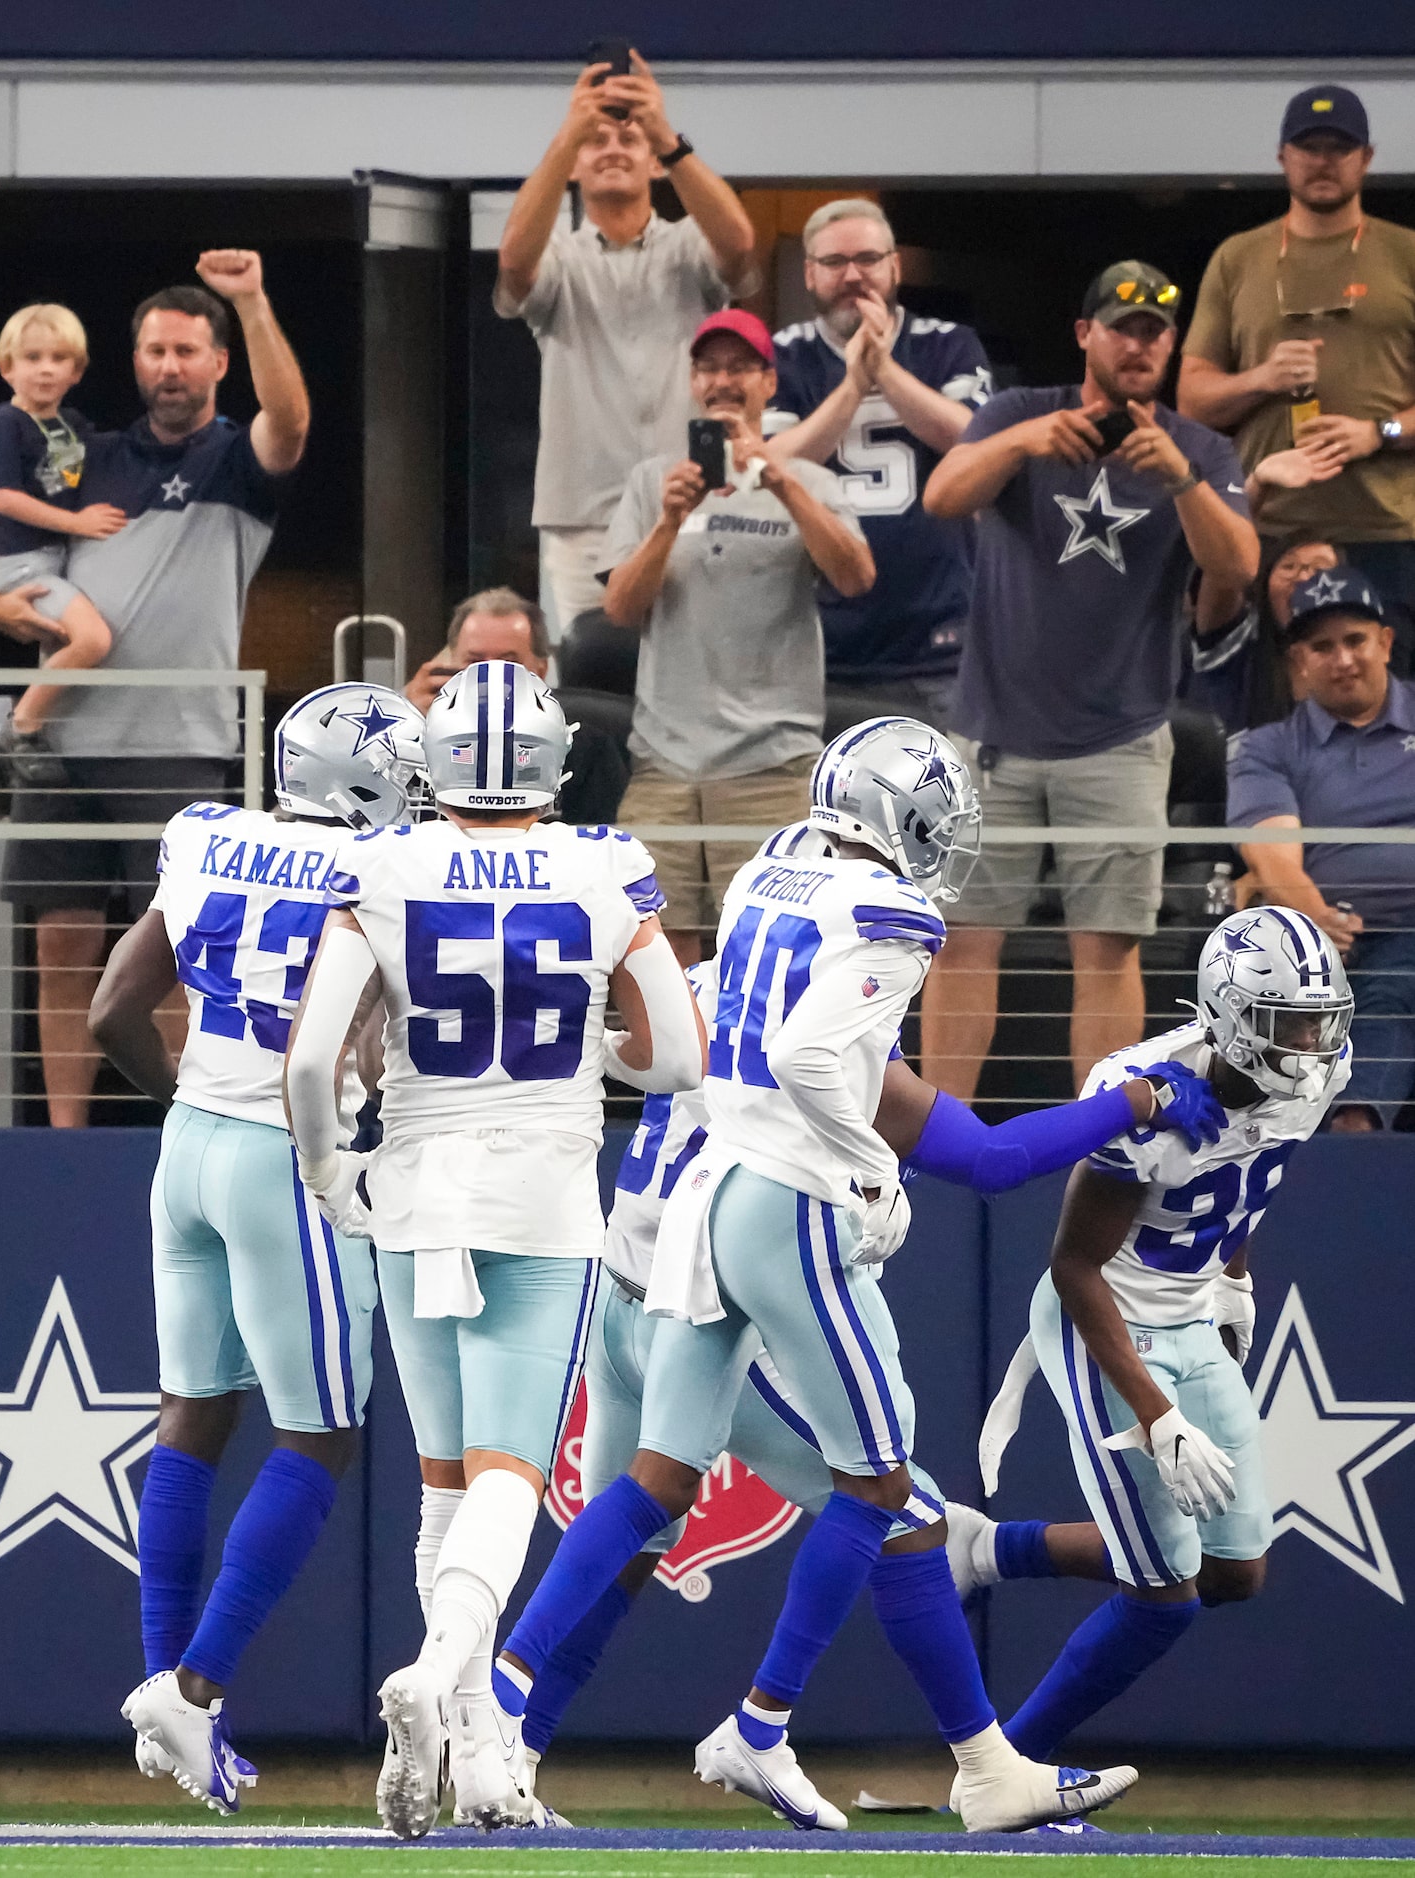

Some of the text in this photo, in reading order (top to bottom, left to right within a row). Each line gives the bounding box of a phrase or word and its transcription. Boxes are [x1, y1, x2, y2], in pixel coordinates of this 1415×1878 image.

[837, 396, 917, 515] 5
[707, 514, 790, 537] COWBOYS
[467, 795, 527, 806] COWBOYS
[443, 849, 551, 890] ANAE
[747, 865, 834, 906] WRIGHT
[175, 891, 334, 1054] 43
[404, 899, 593, 1081] 56
[701, 905, 823, 1089] 40
